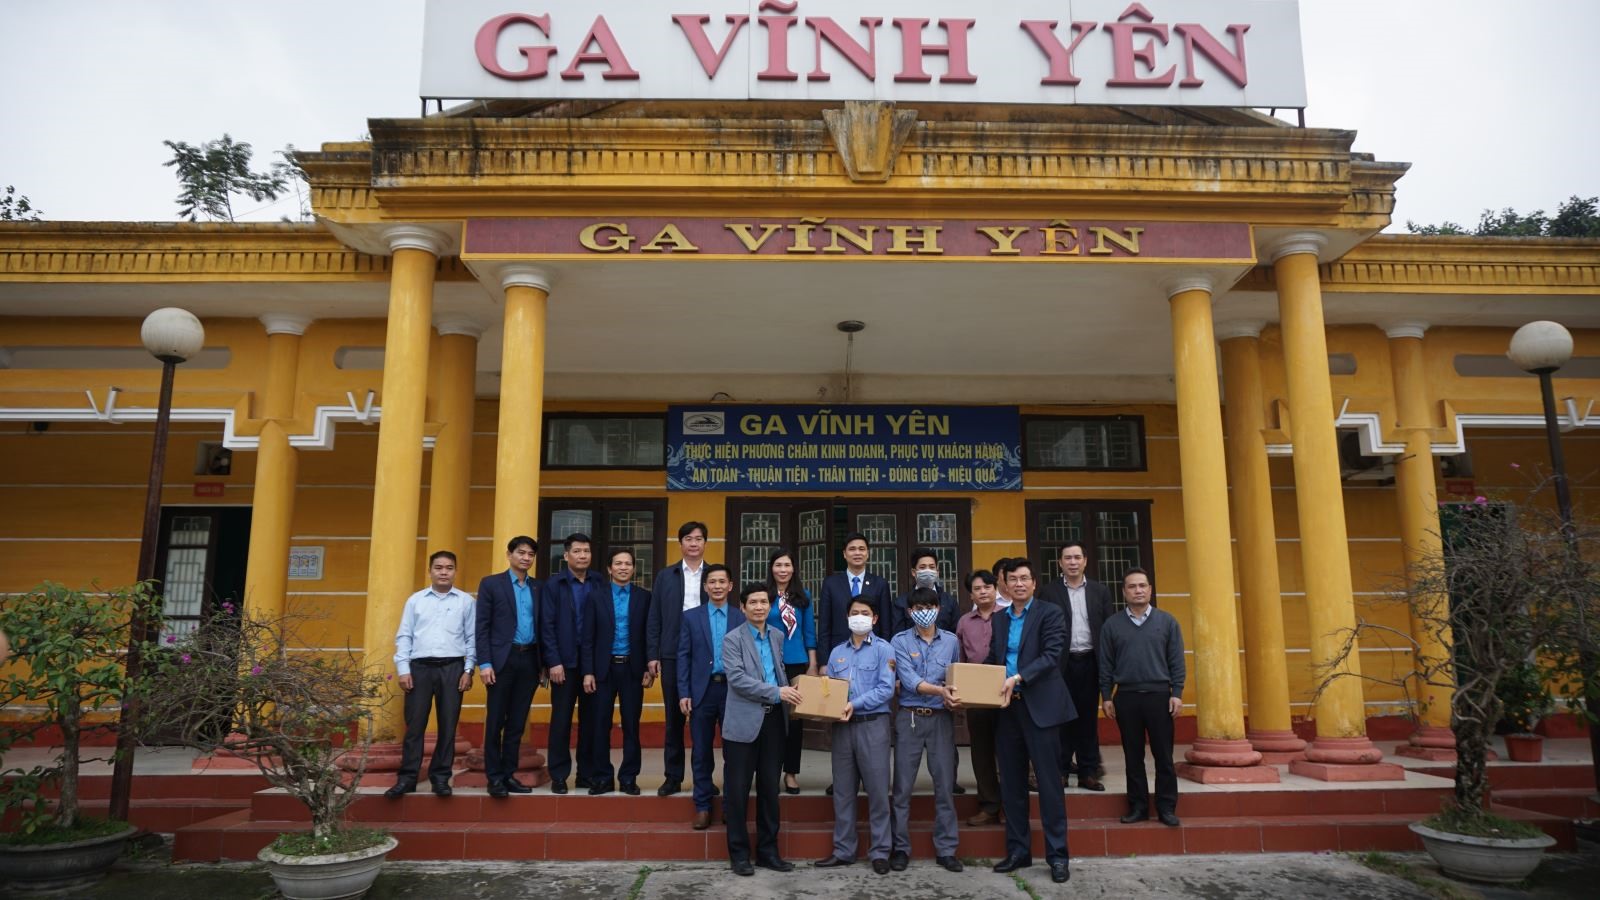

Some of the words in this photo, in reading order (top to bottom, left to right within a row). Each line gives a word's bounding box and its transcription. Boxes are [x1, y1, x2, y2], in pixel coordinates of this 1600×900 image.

[474, 12, 640, 81] GA
[671, 0, 977, 83] VĨNH
[1020, 2, 1251, 88] YÊN
[579, 222, 699, 253] GA
[725, 216, 944, 255] VĨNH
[977, 219, 1145, 256] YÊN
[739, 414, 788, 435] GA
[797, 409, 874, 435] VĨNH
[885, 409, 950, 435] YÊN
[685, 442, 711, 462] THỰC
[714, 441, 739, 462] HIỆN
[742, 442, 785, 459] PHƯƠNG
[787, 441, 818, 459] CHÂM
[821, 444, 846, 459] KINH
[849, 444, 888, 460] DOANH,
[890, 444, 919, 462] PHỤC
[921, 444, 935, 462] VỤ
[937, 441, 972, 459] KHÁCH
[975, 442, 1004, 459] HÀNG
[692, 467, 707, 482] AN
[710, 464, 738, 482] TOÀN
[748, 465, 783, 485] THUẬN
[785, 465, 808, 485] TIỆN
[818, 465, 846, 482] THÂN
[849, 465, 879, 485] THIỆN
[889, 465, 918, 482] ĐÚNG
[921, 464, 939, 482] GIỜ
[948, 465, 972, 485] HIỆU
[975, 464, 997, 483] QUẢ
